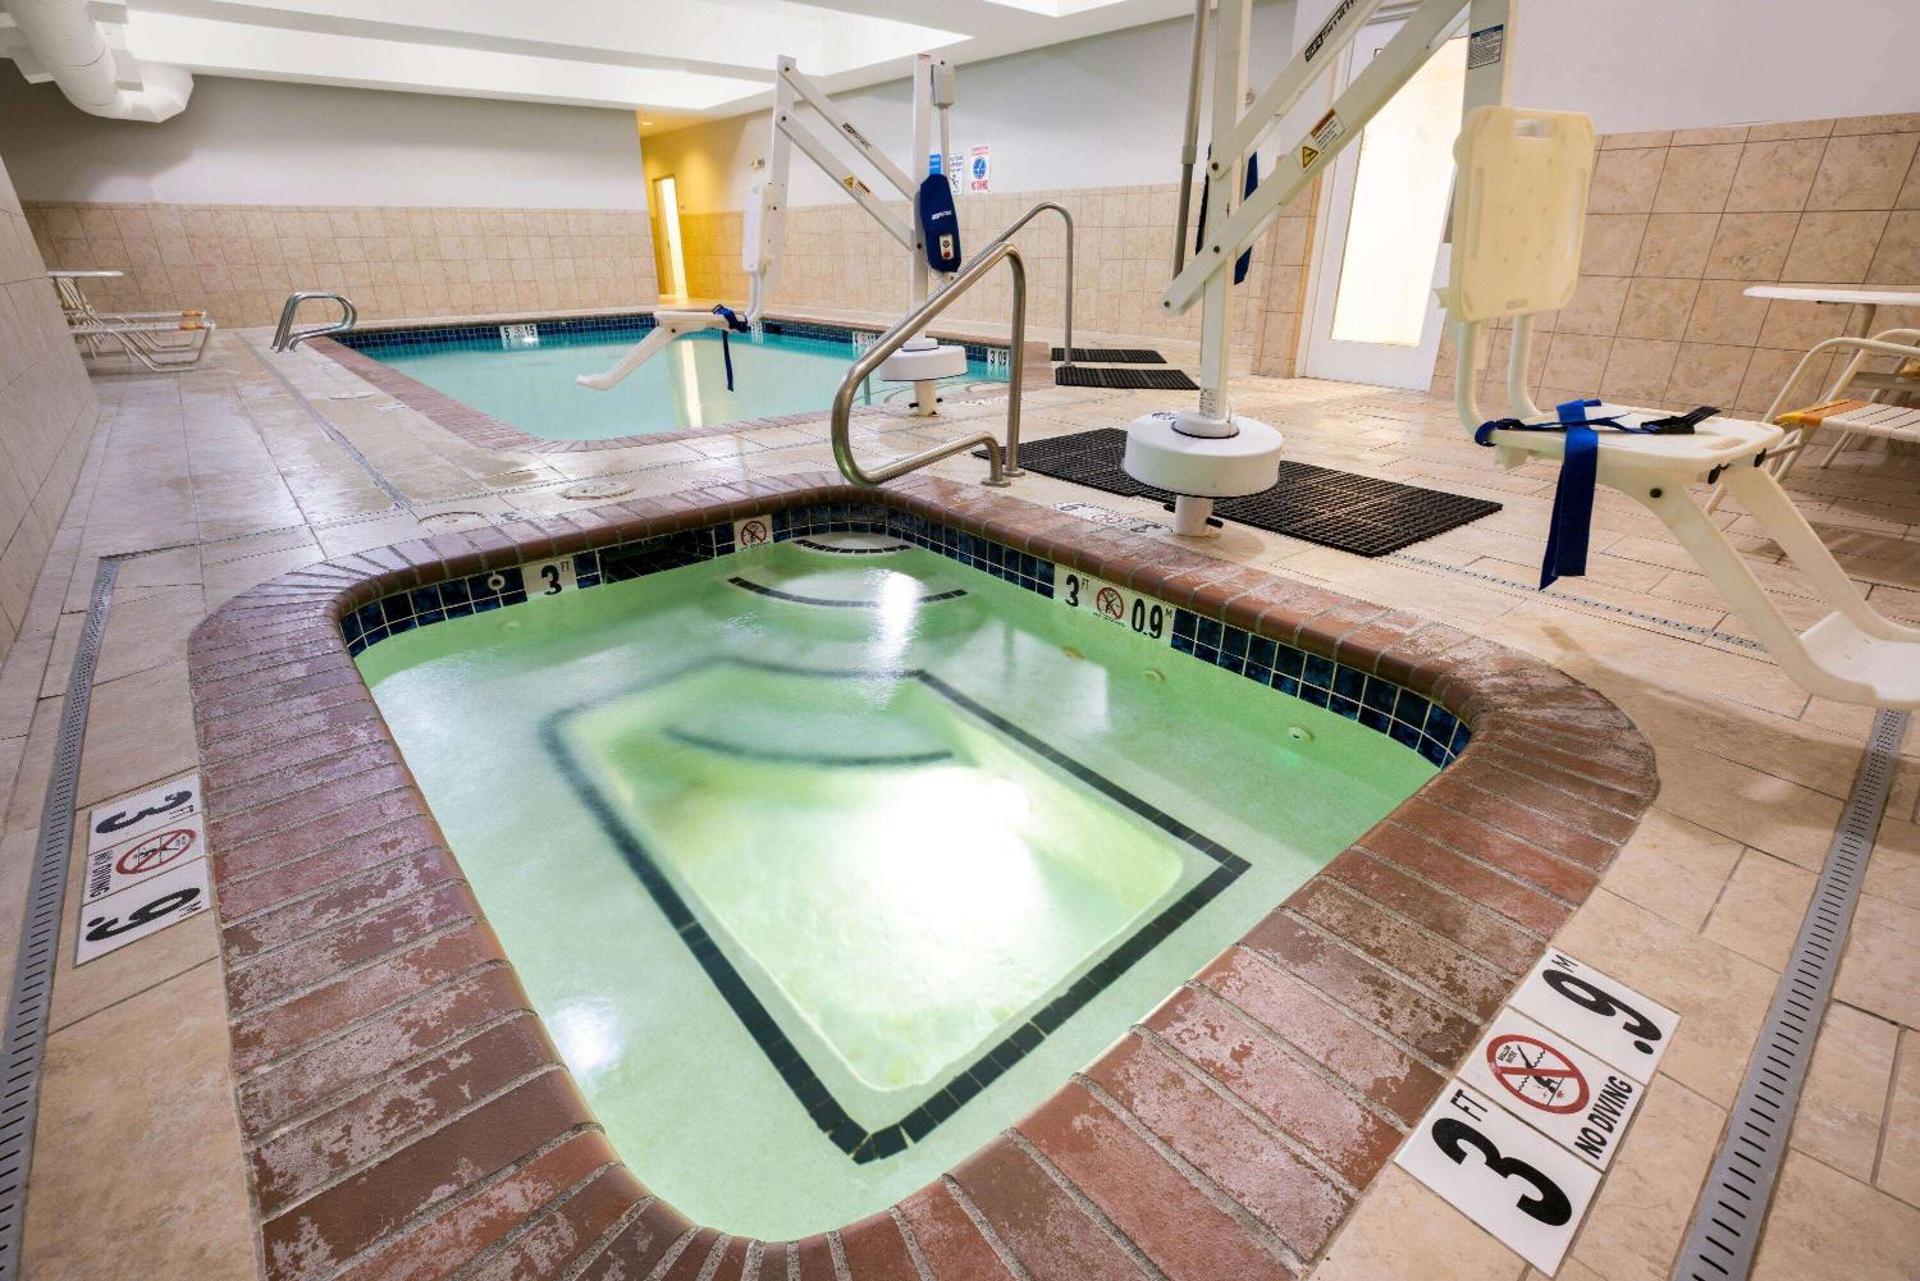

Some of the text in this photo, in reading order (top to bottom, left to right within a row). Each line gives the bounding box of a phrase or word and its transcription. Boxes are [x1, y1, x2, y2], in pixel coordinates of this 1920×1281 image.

[540, 564, 563, 595] 3
[1065, 574, 1080, 607] 3
[1131, 598, 1164, 639] 0.9
[95, 790, 193, 834] 3
[89, 849, 114, 899] NO DIVING
[1552, 953, 1579, 973] M
[1573, 1075, 1633, 1161] NO DIVING
[1431, 1089, 1573, 1227] 3 FT
